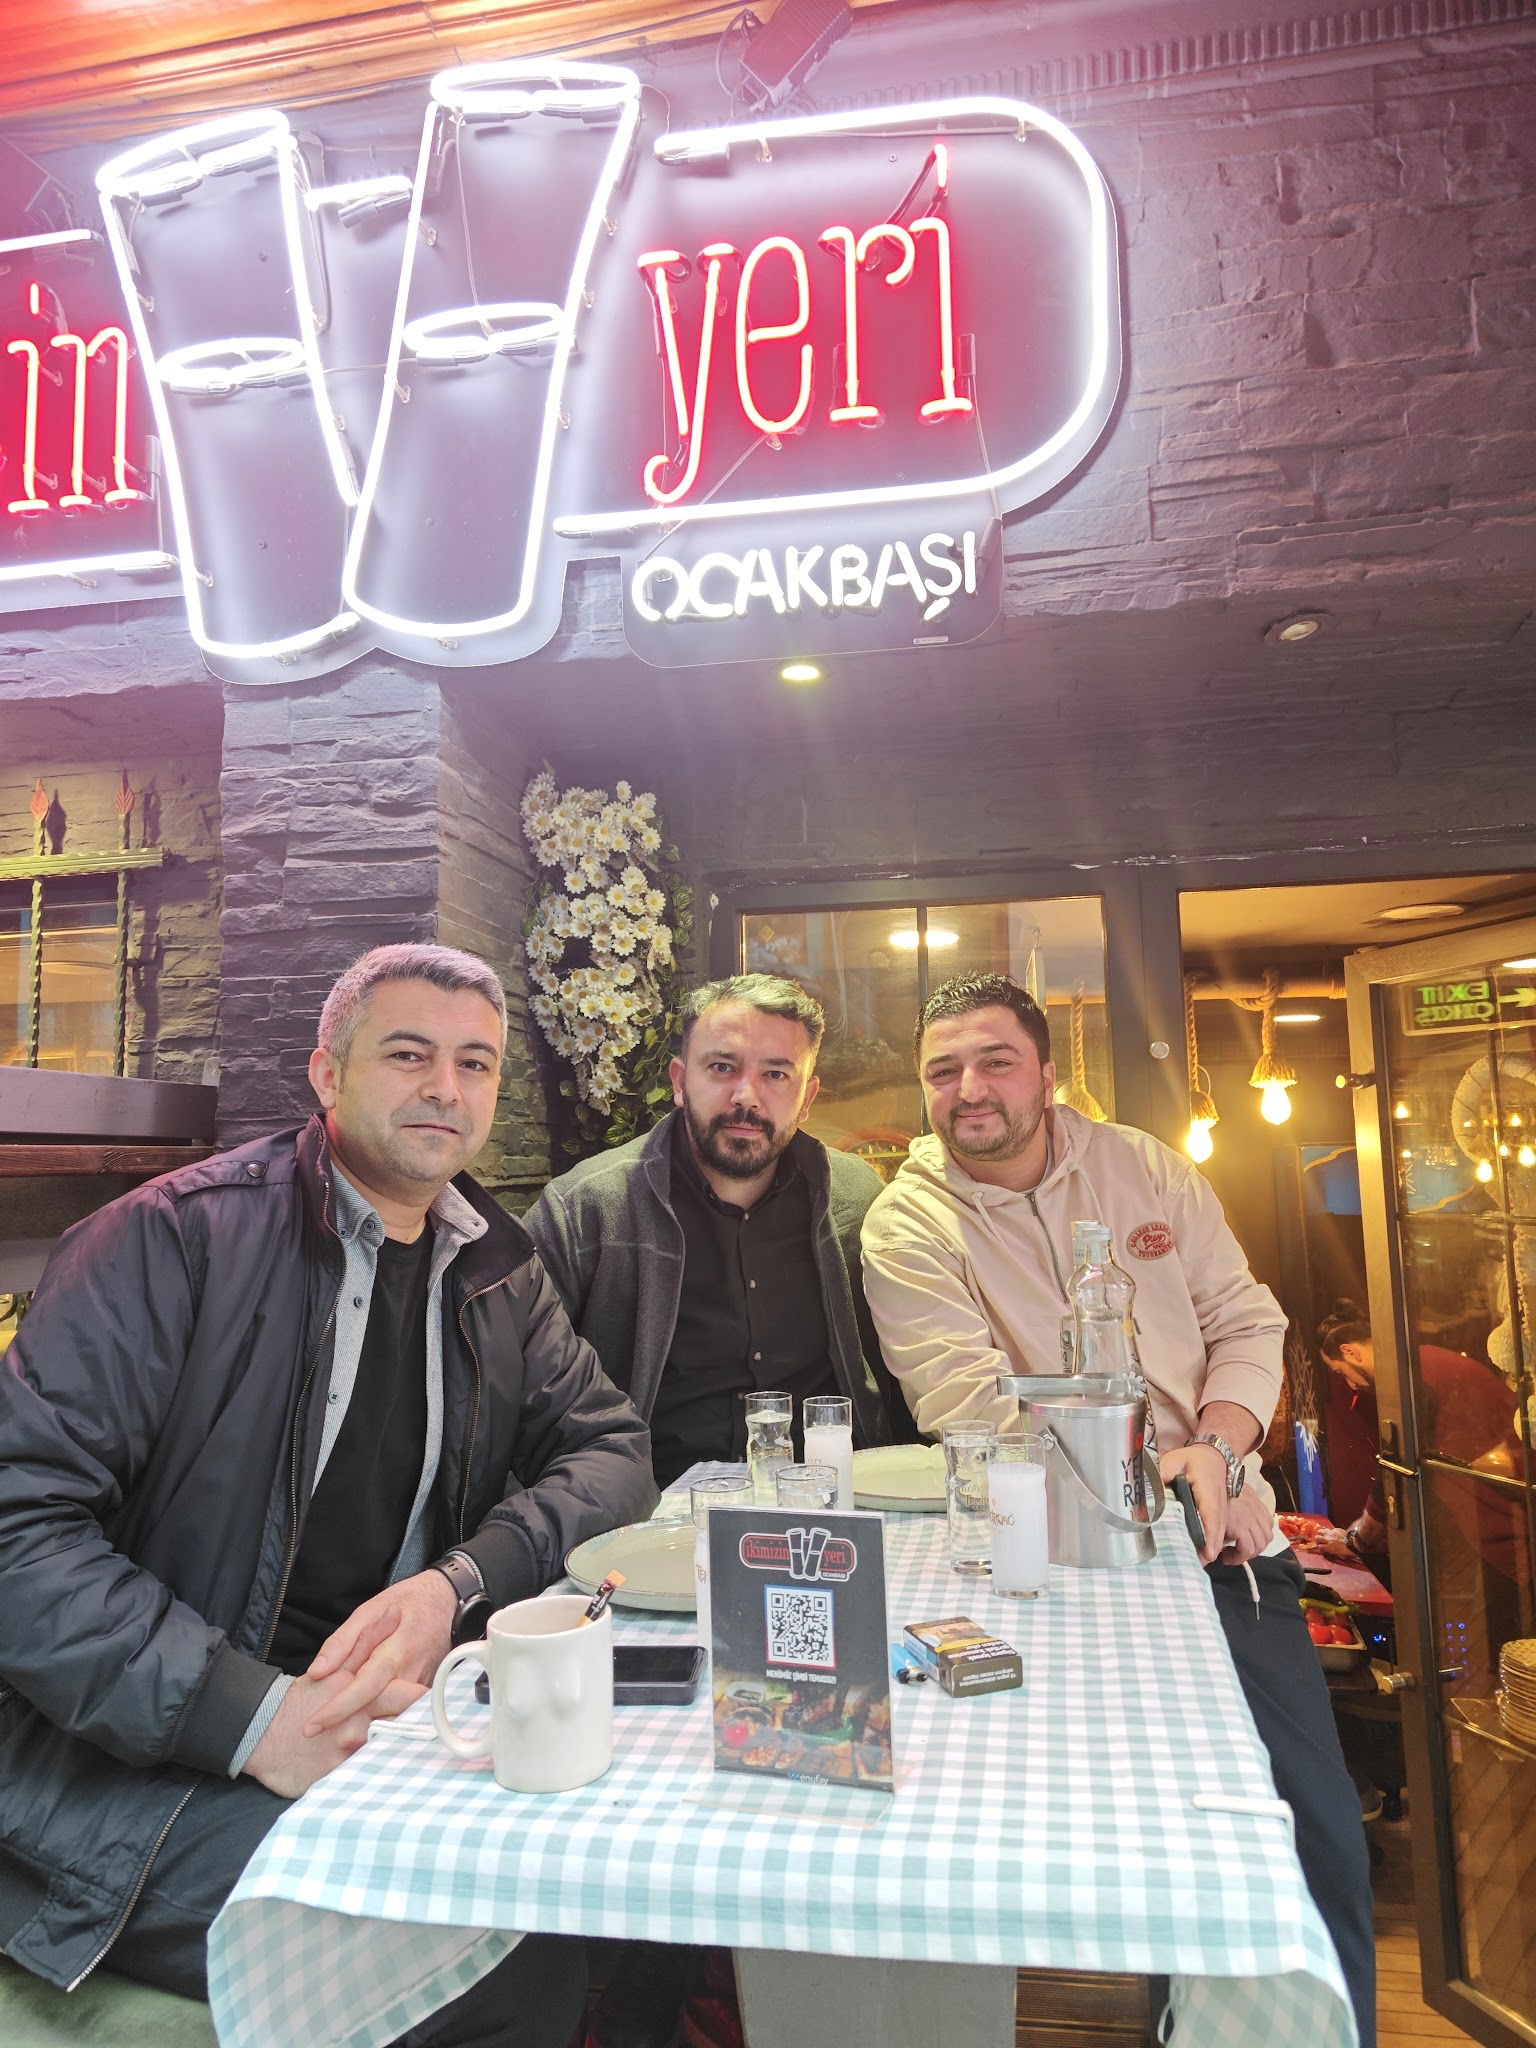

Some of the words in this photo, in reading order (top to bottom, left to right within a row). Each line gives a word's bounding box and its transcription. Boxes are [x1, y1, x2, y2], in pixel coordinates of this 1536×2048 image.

[637, 144, 974, 504] yeri
[632, 530, 976, 621] OCAKBAŞI
[824, 1545, 846, 1567] yeri
